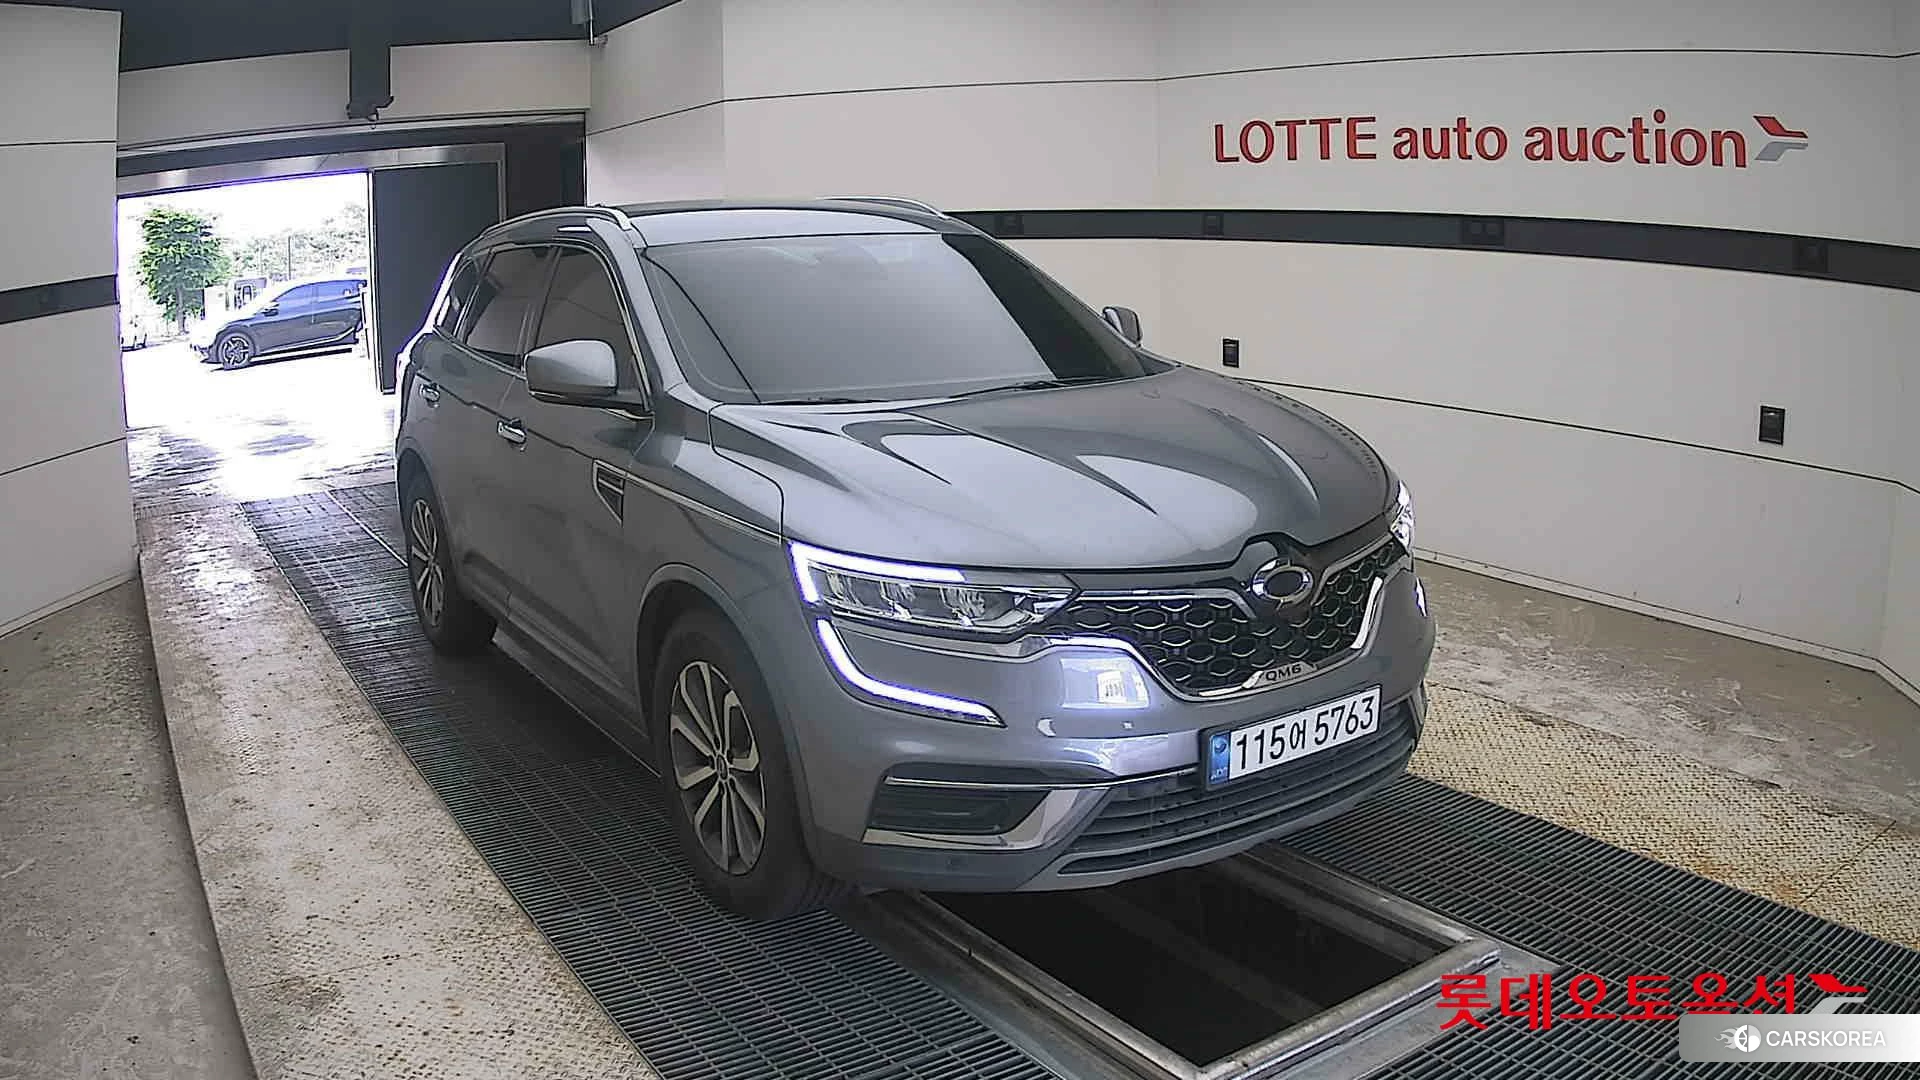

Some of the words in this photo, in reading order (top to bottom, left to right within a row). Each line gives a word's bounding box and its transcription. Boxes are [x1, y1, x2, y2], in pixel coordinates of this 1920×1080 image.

[1214, 116, 1377, 164] LOTTE
[1392, 117, 1509, 161] auto
[1523, 109, 1748, 168] auction
[1265, 666, 1302, 682] QM6
[1236, 719, 1307, 770] 115어
[1314, 696, 1374, 745] 5763
